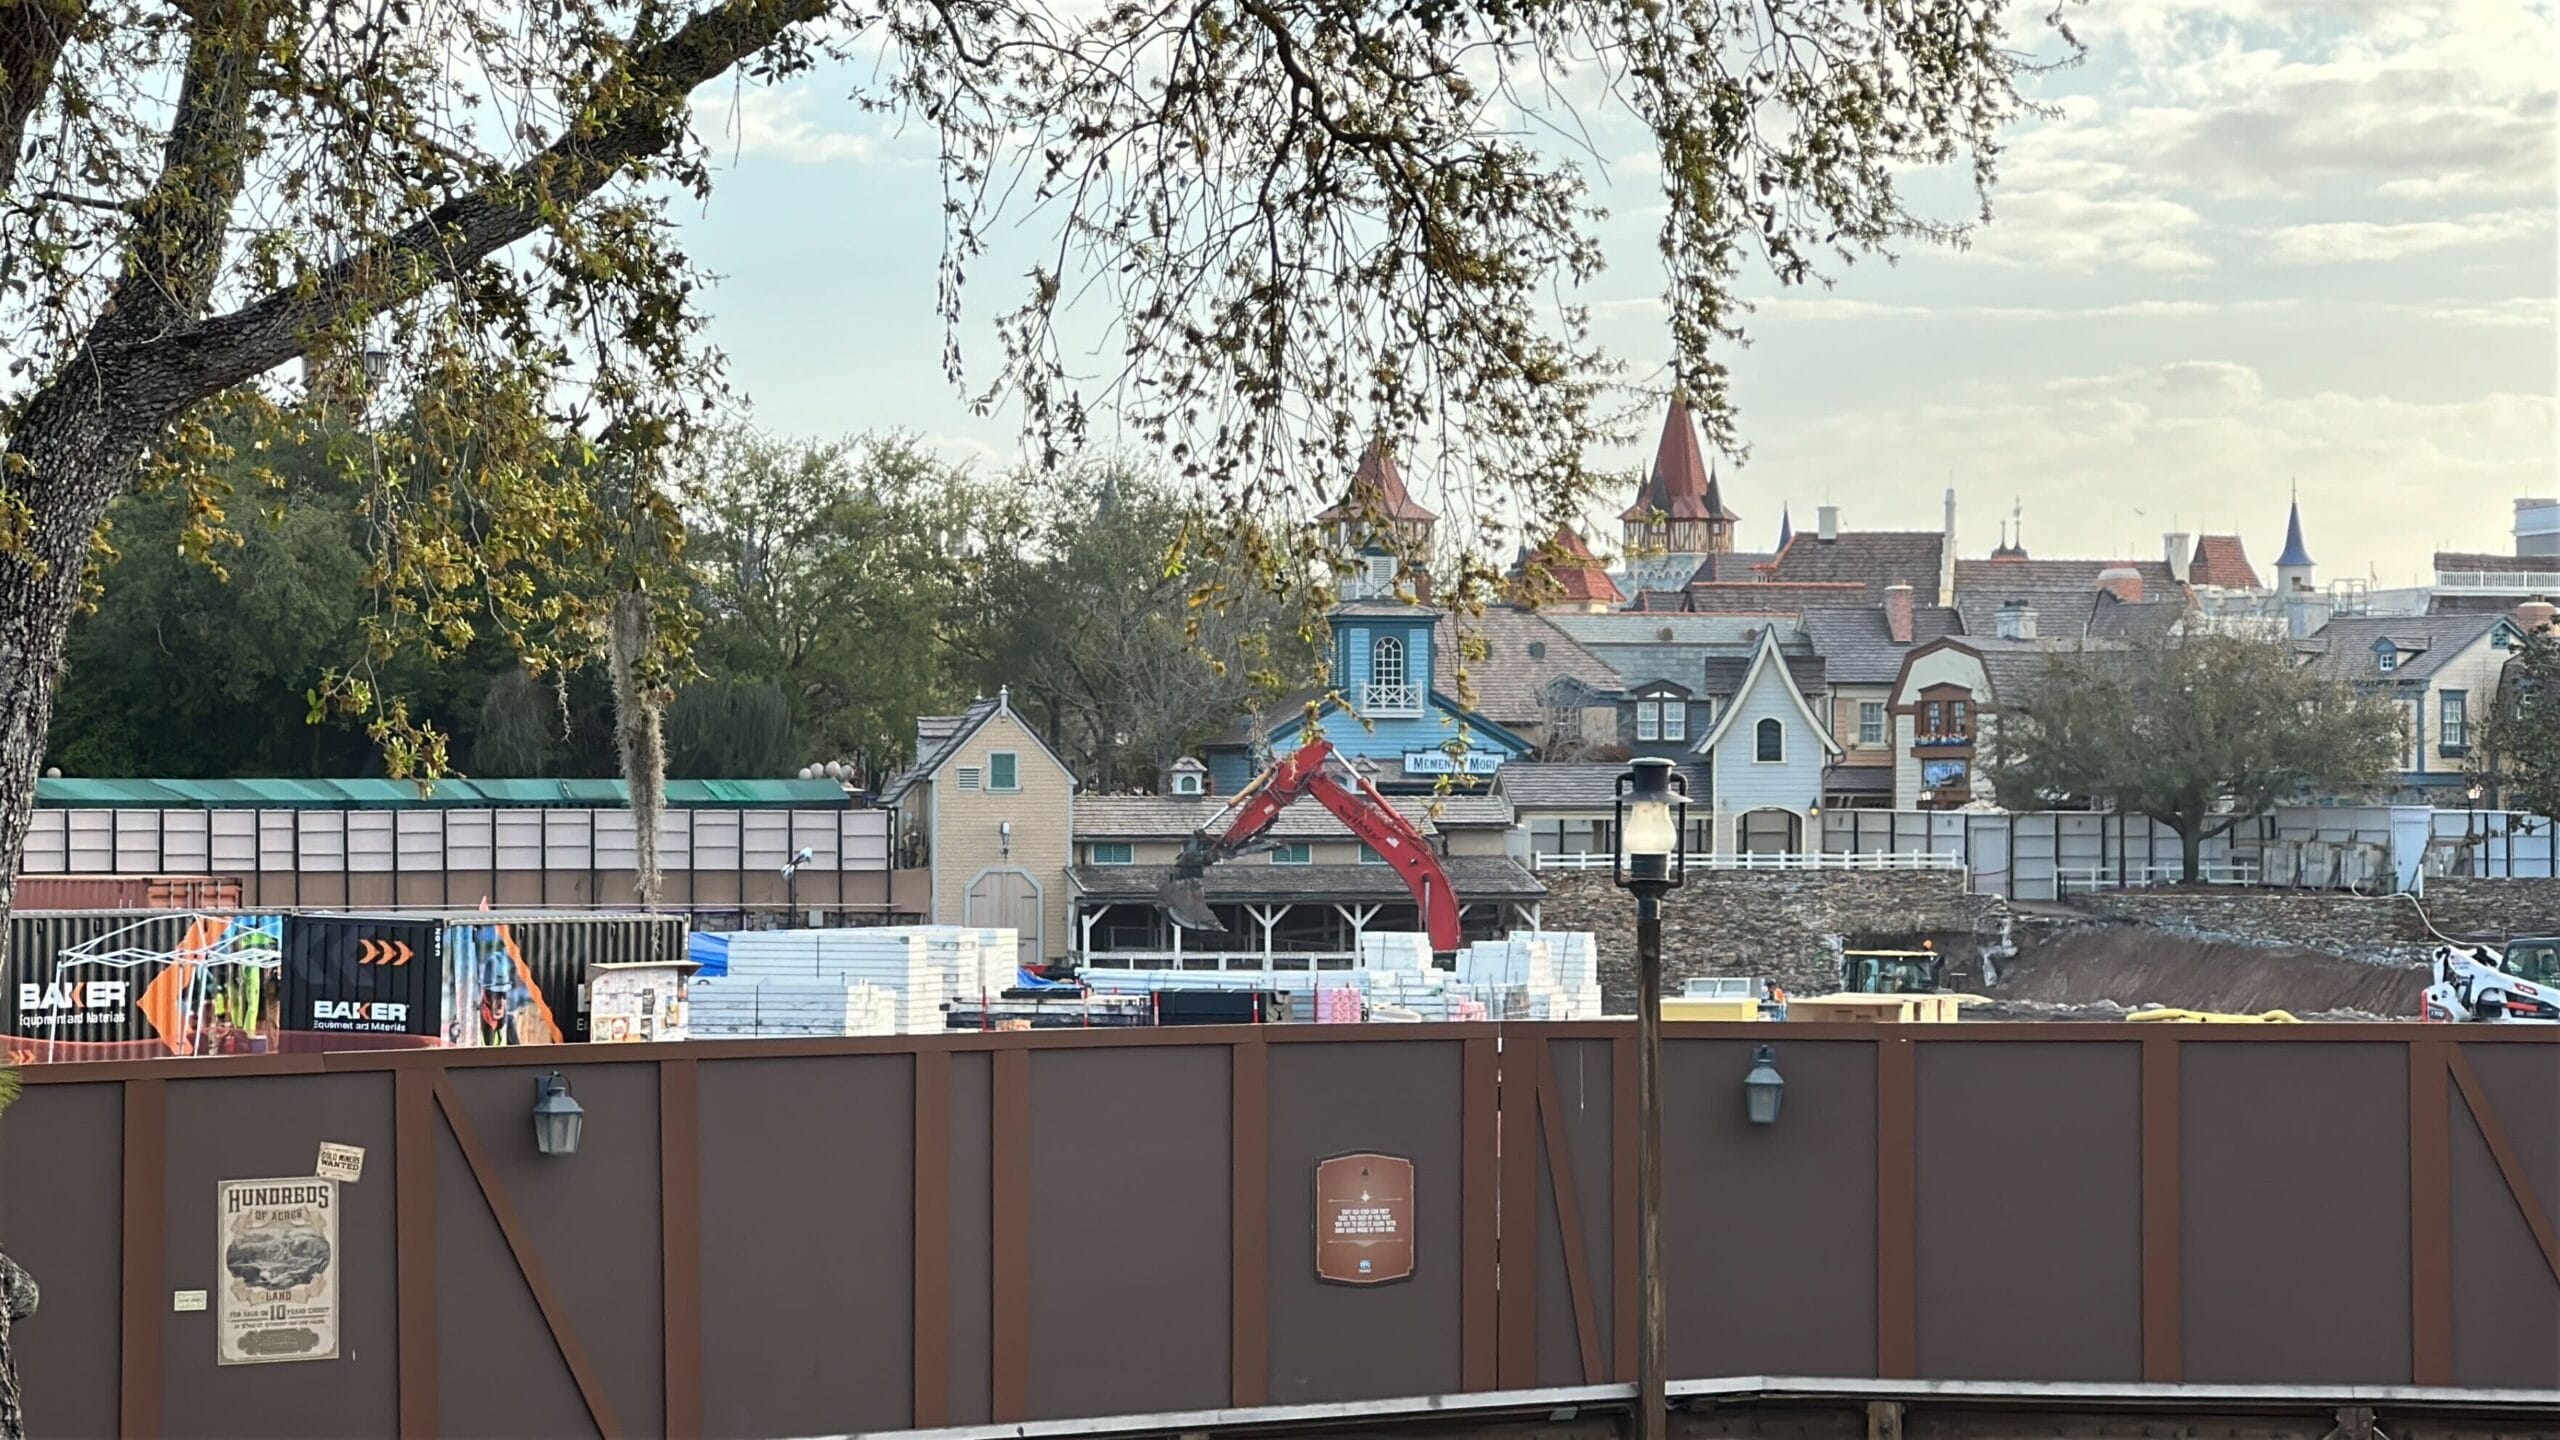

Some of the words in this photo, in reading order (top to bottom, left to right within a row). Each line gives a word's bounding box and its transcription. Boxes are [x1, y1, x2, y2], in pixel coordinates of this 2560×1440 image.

[1469, 758, 1496, 771] MORI
[19, 981, 126, 1010] BAKER
[313, 1000, 407, 1022] BAKER
[320, 1159, 360, 1172] WANTED
[228, 1184, 329, 1214] HUNDREDS
[271, 1208, 303, 1221] ACRES
[265, 1291, 292, 1302] LAND
[269, 1304, 286, 1321] 10
